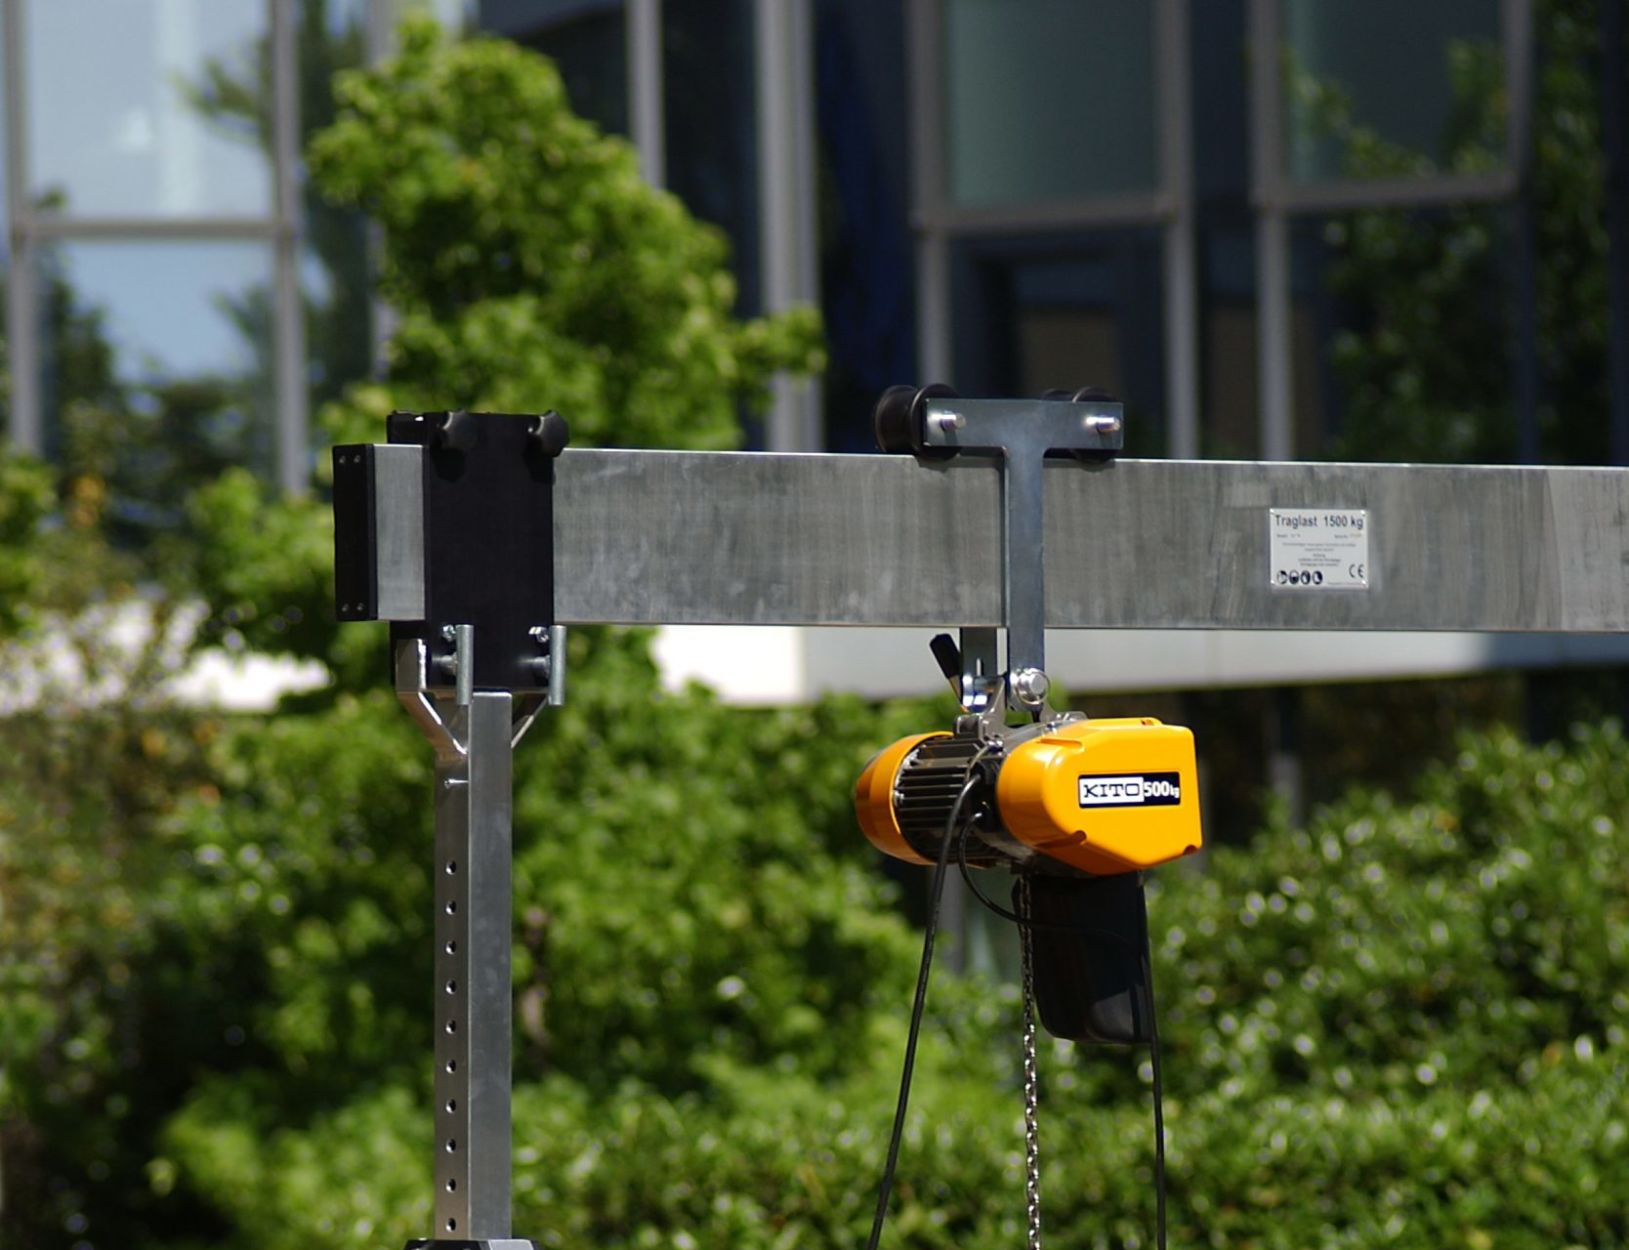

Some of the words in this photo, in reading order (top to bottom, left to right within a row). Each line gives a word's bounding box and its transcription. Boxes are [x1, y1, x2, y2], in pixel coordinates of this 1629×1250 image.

[1276, 515, 1318, 529] Traglast
[1324, 515, 1348, 527] 1500
[1351, 515, 1364, 530] kg
[1083, 783, 1140, 798] KITO
